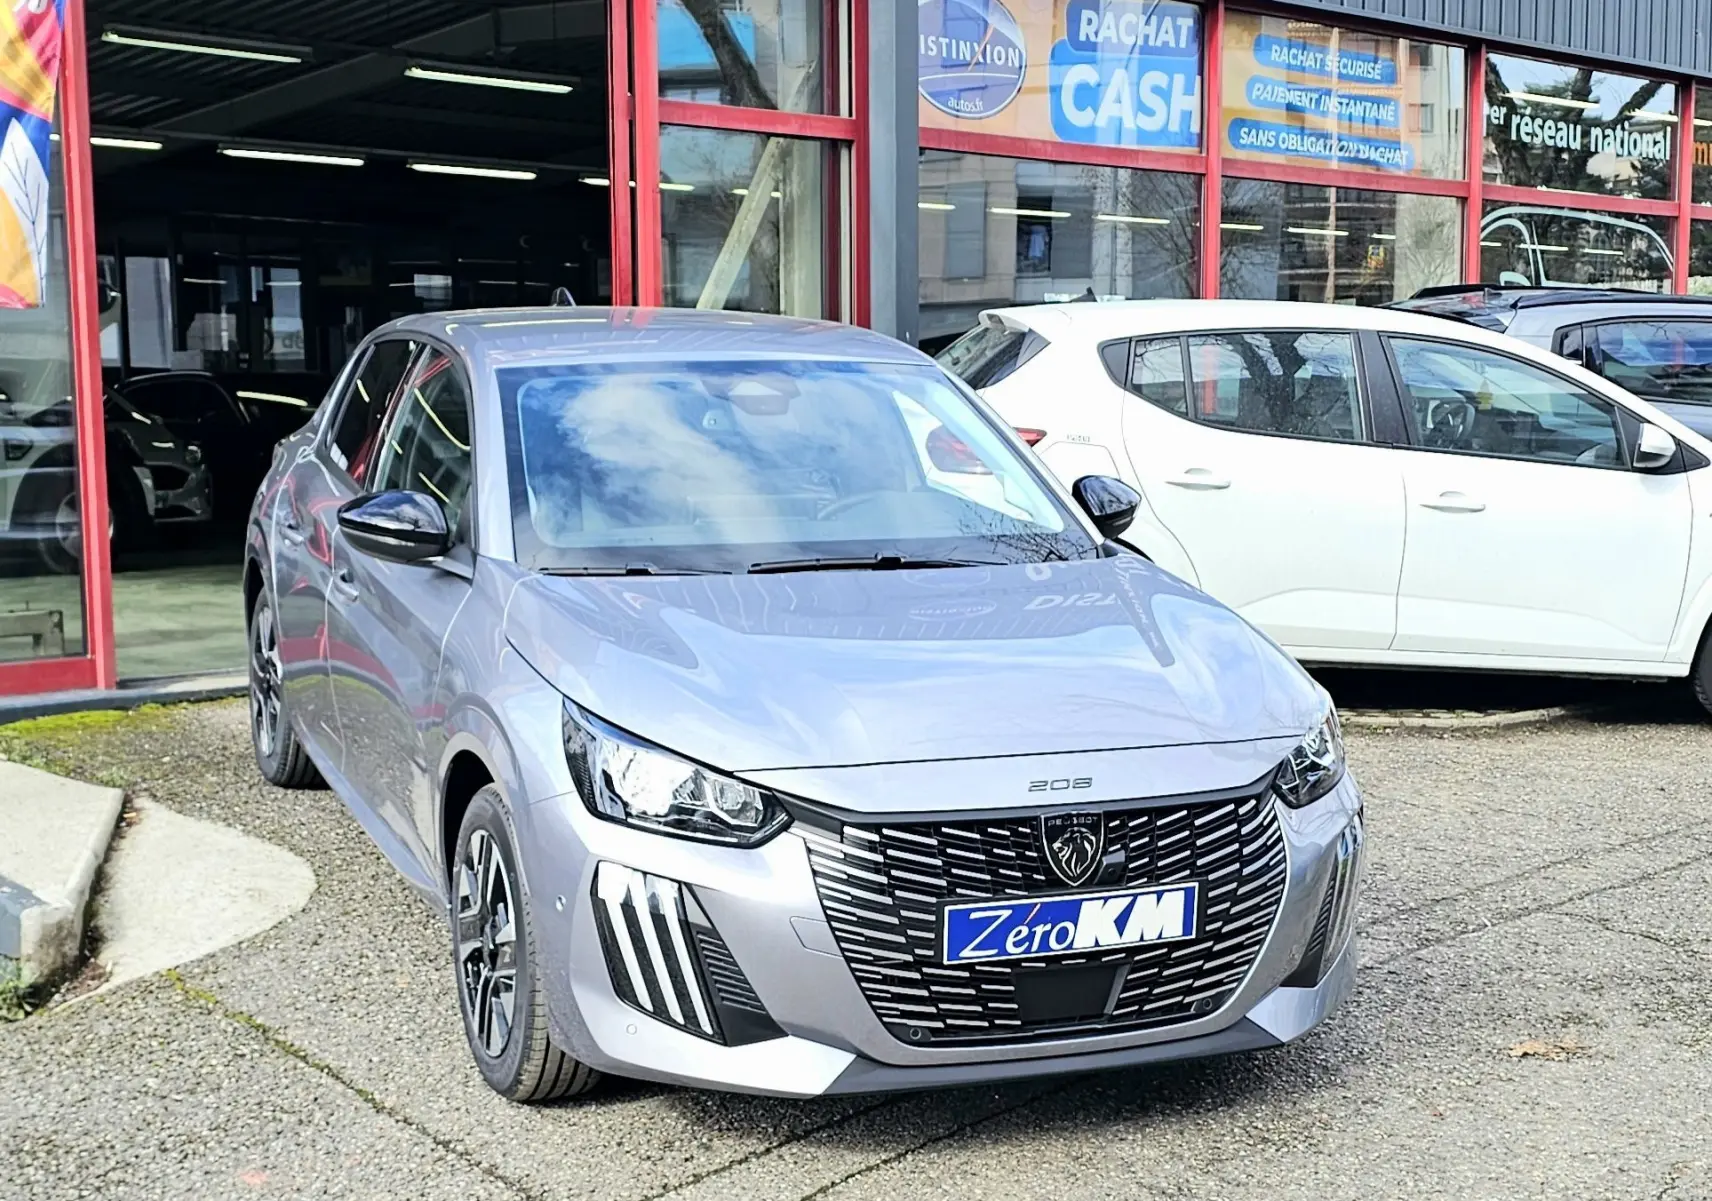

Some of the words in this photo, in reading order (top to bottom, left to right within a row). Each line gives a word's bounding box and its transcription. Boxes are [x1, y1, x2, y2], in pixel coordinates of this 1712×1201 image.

[1079, 9, 1194, 49] RACHAT
[919, 32, 1020, 69] ISTINXION
[1271, 43, 1323, 69] RACHAT
[1324, 50, 1383, 80] SÉCURISÉ
[947, 96, 984, 113] autos.fr
[1060, 63, 1201, 134] CASH
[1252, 82, 1319, 111] PAIEMENT
[1320, 95, 1396, 121] INSTANTANÉ
[1239, 127, 1277, 148] SANS
[1510, 106, 1582, 150] réseau
[1590, 122, 1672, 160] national
[1027, 777, 1093, 792] 208
